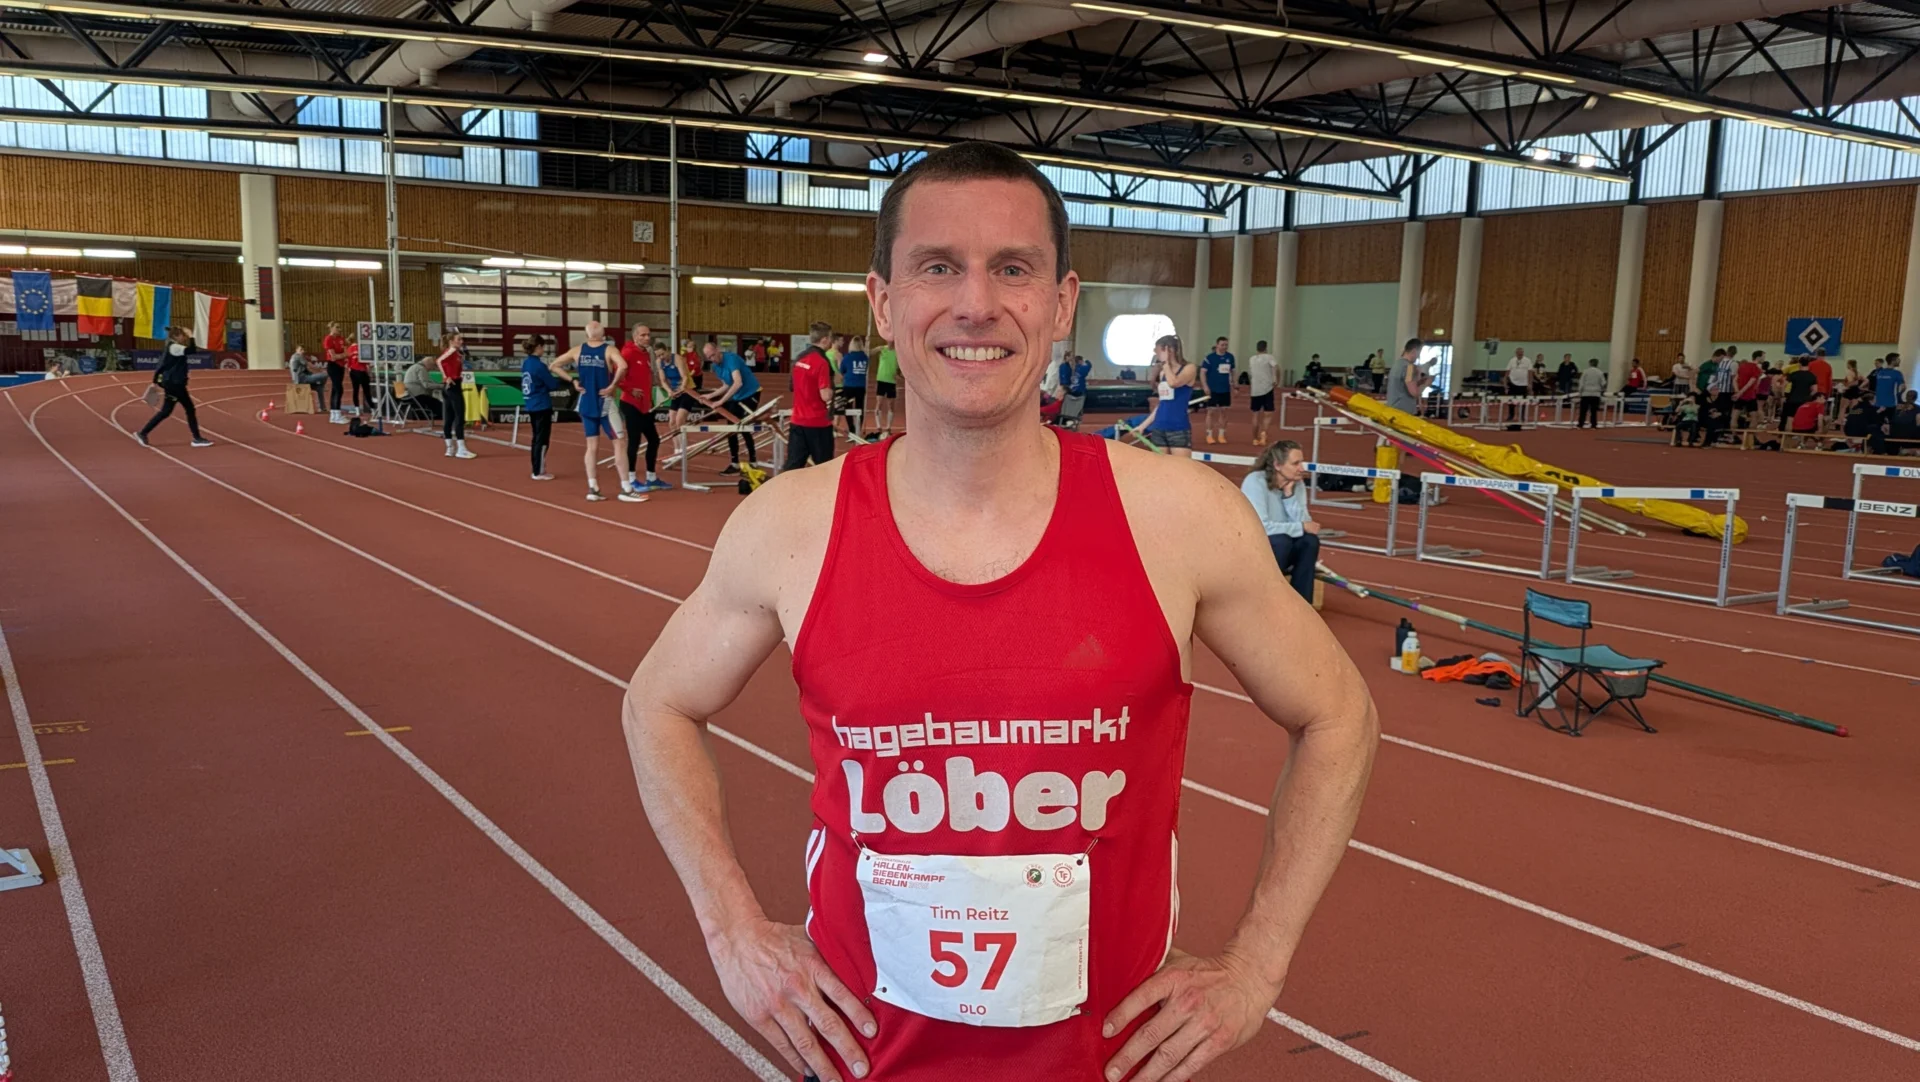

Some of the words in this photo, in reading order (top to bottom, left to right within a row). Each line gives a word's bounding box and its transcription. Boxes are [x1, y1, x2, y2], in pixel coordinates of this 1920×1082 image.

[1458, 477, 1515, 489] OLYMPIAPARK
[1859, 502, 1912, 515] BENZ
[832, 706, 1130, 757] hagebaumarkt
[841, 756, 1126, 833] Löber
[873, 861, 914, 871] HALLEN-
[872, 869, 945, 882] SIEBENKAMPF
[872, 877, 907, 887] BERLIN
[930, 906, 961, 920] Tim
[966, 907, 1009, 921] Reitz
[929, 930, 1017, 990] 57
[959, 1003, 987, 1016] DLO
